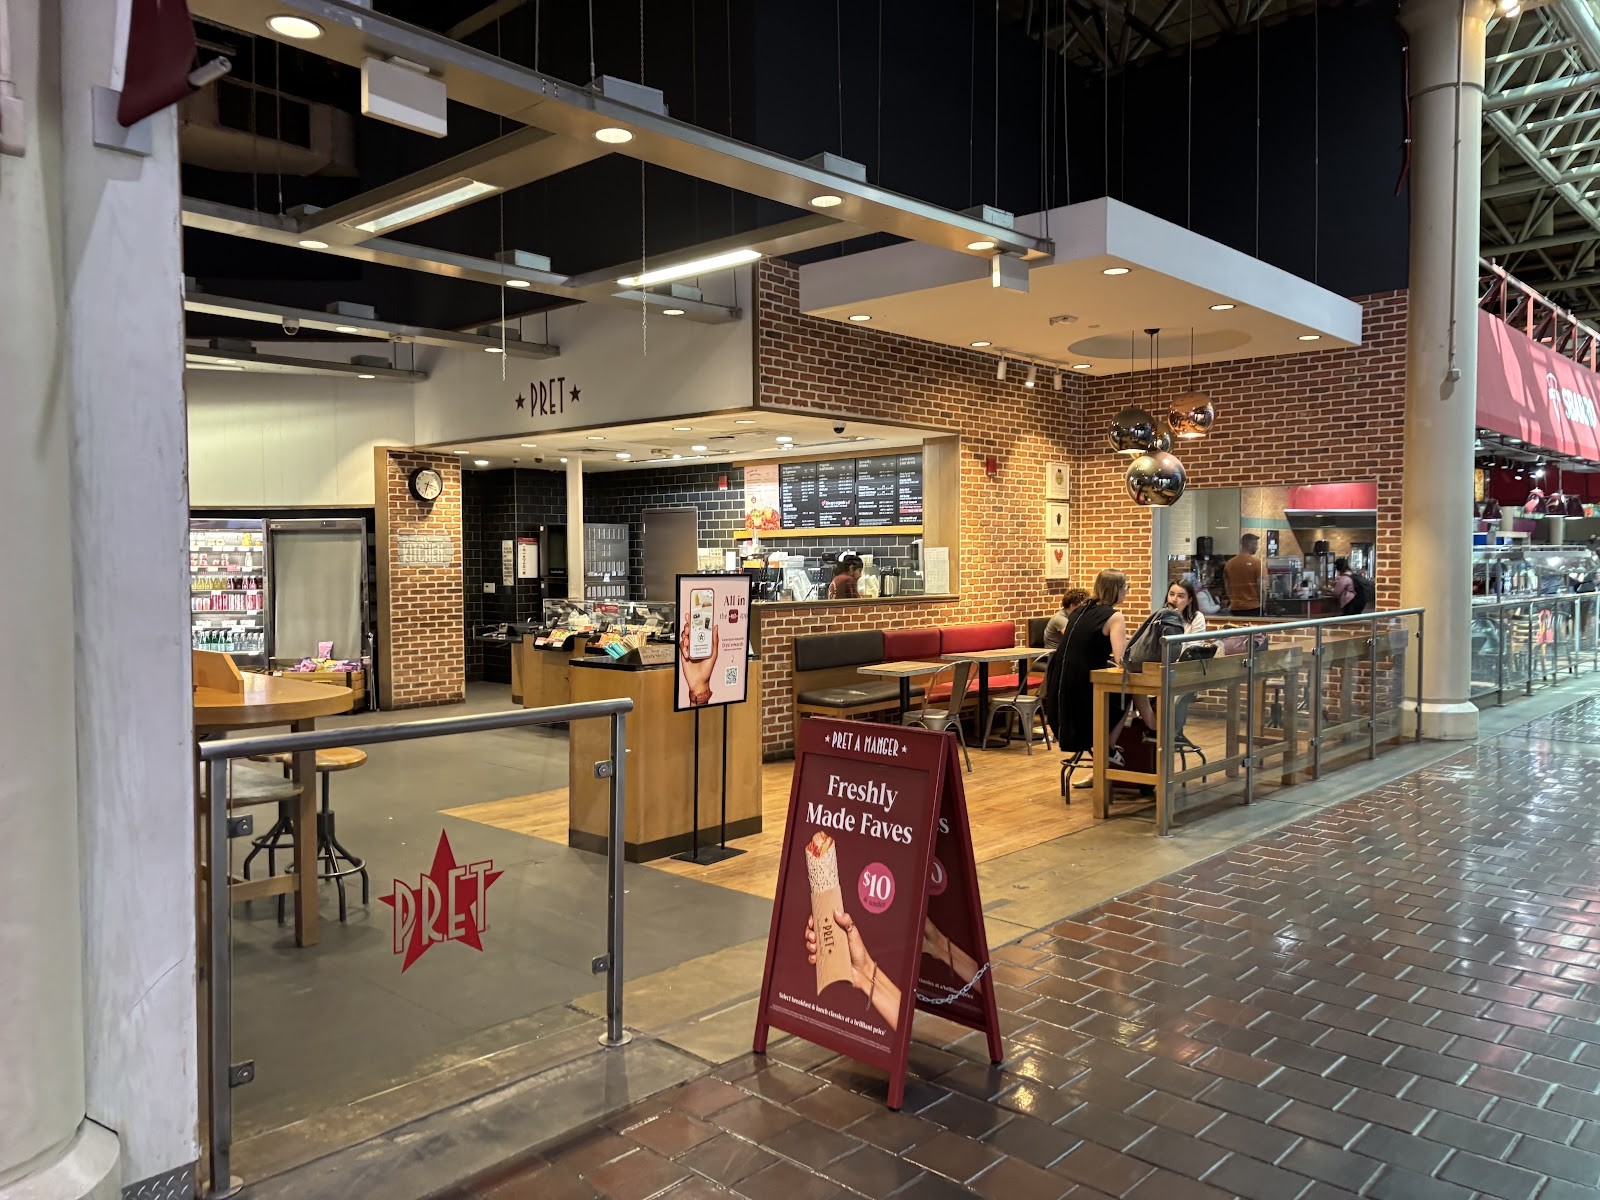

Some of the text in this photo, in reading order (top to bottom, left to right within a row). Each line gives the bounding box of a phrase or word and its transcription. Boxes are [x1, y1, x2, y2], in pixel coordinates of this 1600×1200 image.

[531, 377, 565, 417] PRET
[723, 594, 746, 606] All in
[831, 731, 899, 757] PRET A MANGER
[827, 774, 899, 813] Freshly
[805, 801, 856, 832] Made
[859, 812, 913, 845] Faves
[862, 870, 891, 901] $10
[393, 859, 493, 955] PRET
[822, 924, 835, 947] PRET
[791, 996, 811, 1009] breakfast
